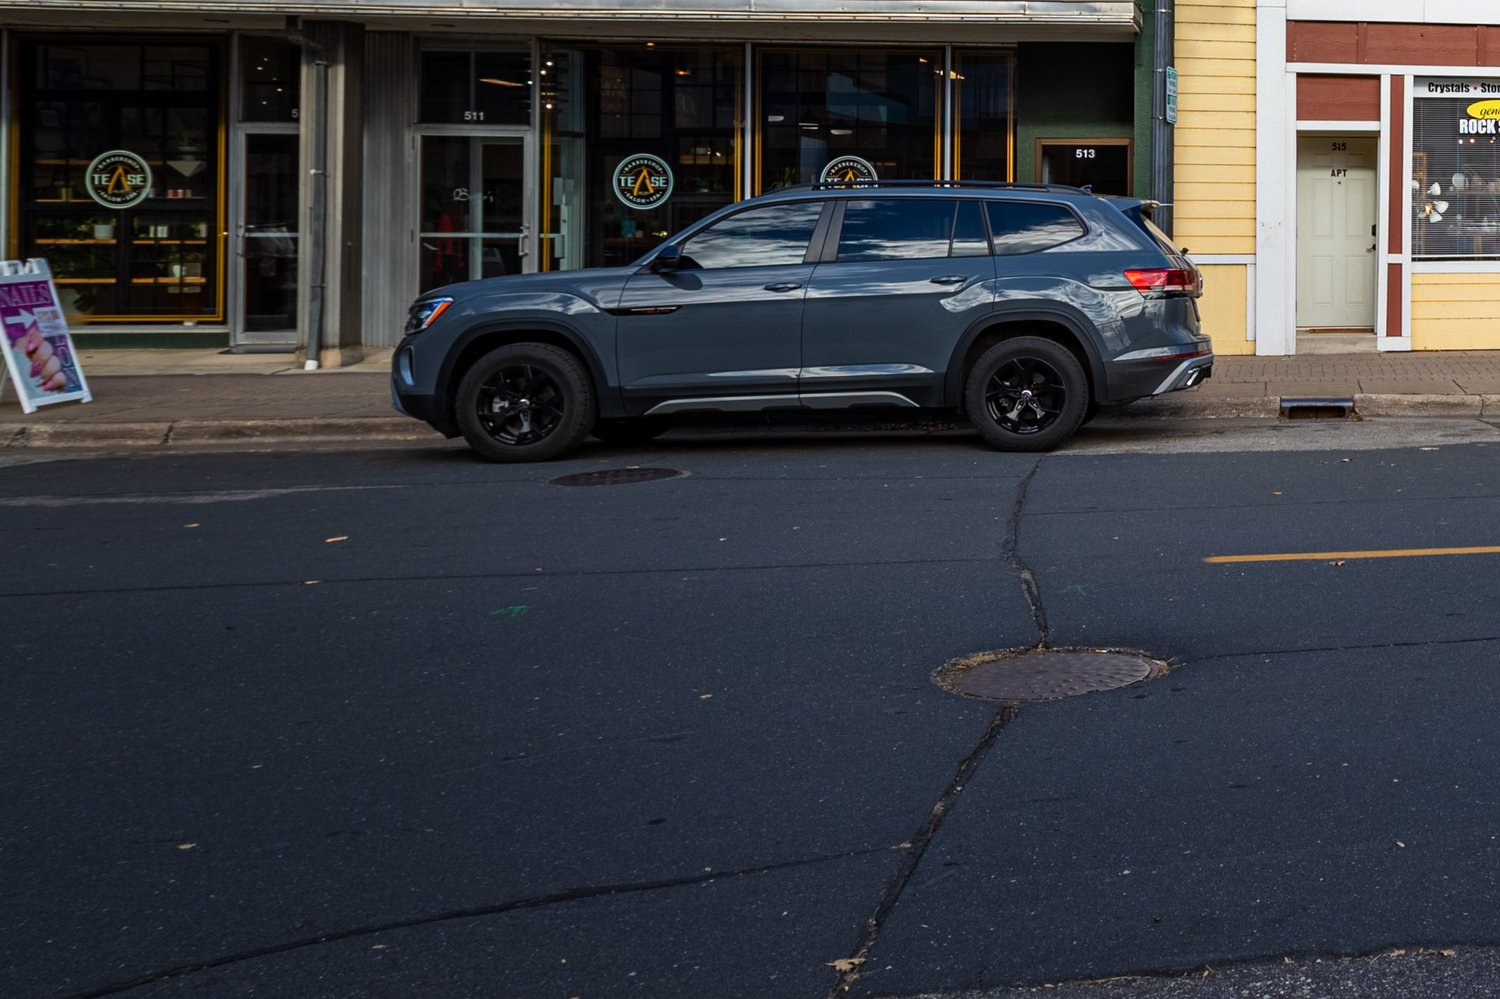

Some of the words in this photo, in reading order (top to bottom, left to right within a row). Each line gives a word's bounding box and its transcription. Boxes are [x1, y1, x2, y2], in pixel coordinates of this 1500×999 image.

[1427, 82, 1470, 94] Crystals
[464, 111, 485, 120] 511
[1459, 119, 1495, 134] ROCK
[1332, 142, 1347, 151] 515
[1075, 148, 1095, 158] 513
[1331, 169, 1348, 177] APT
